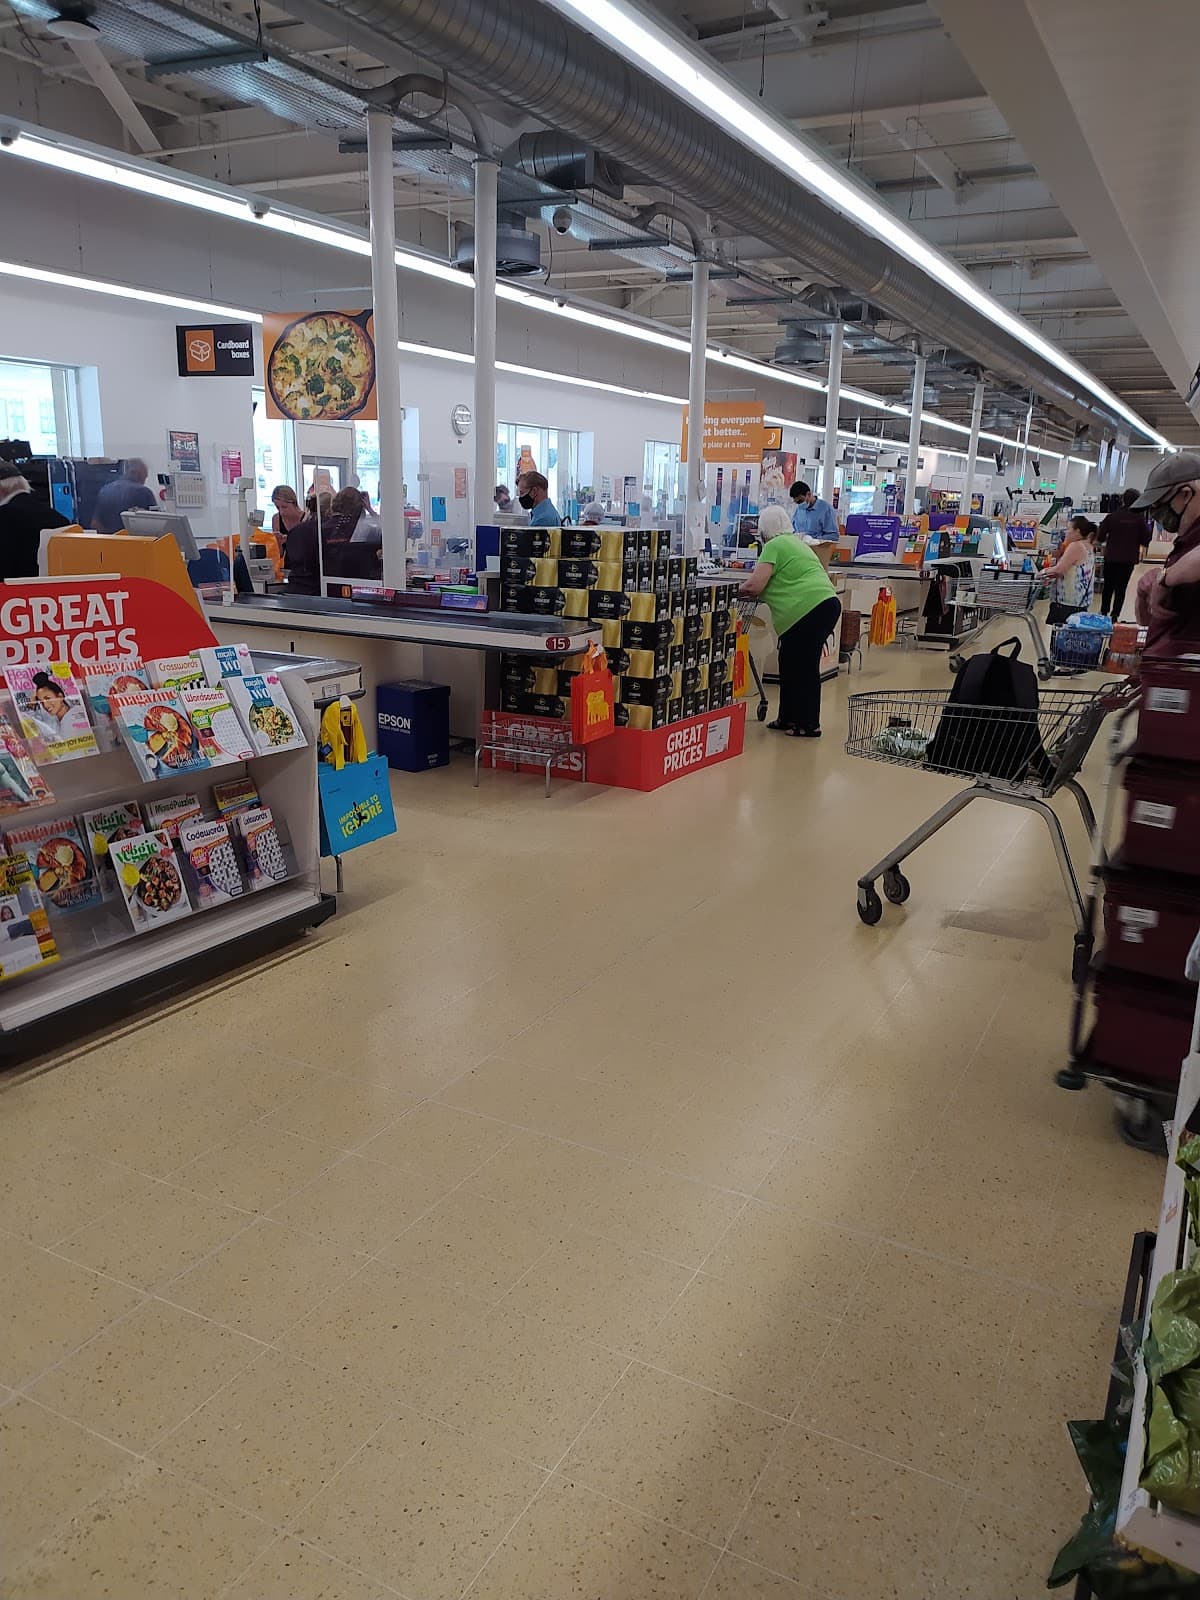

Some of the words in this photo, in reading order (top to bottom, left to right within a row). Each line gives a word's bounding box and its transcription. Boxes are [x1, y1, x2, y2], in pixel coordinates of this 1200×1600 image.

[216, 340, 250, 350] Cardboard
[231, 350, 250, 359] boxes
[720, 416, 761, 426] everyone
[707, 441, 723, 449] plate
[0, 590, 130, 636] GREAT
[0, 628, 139, 666] PRICES
[552, 637, 566, 650] 15
[158, 660, 199, 672] Crosswords
[117, 690, 178, 707] magazine
[184, 692, 225, 703] Wordsearch
[378, 713, 411, 730] EPSON
[667, 723, 704, 753] GREAT
[664, 742, 704, 775] PRICES
[338, 799, 370, 825] IMPOSSIBLE
[369, 793, 379, 803] TO
[341, 801, 383, 838] IGNORE
[186, 824, 225, 842] Codewords
[116, 840, 158, 863] veggie
